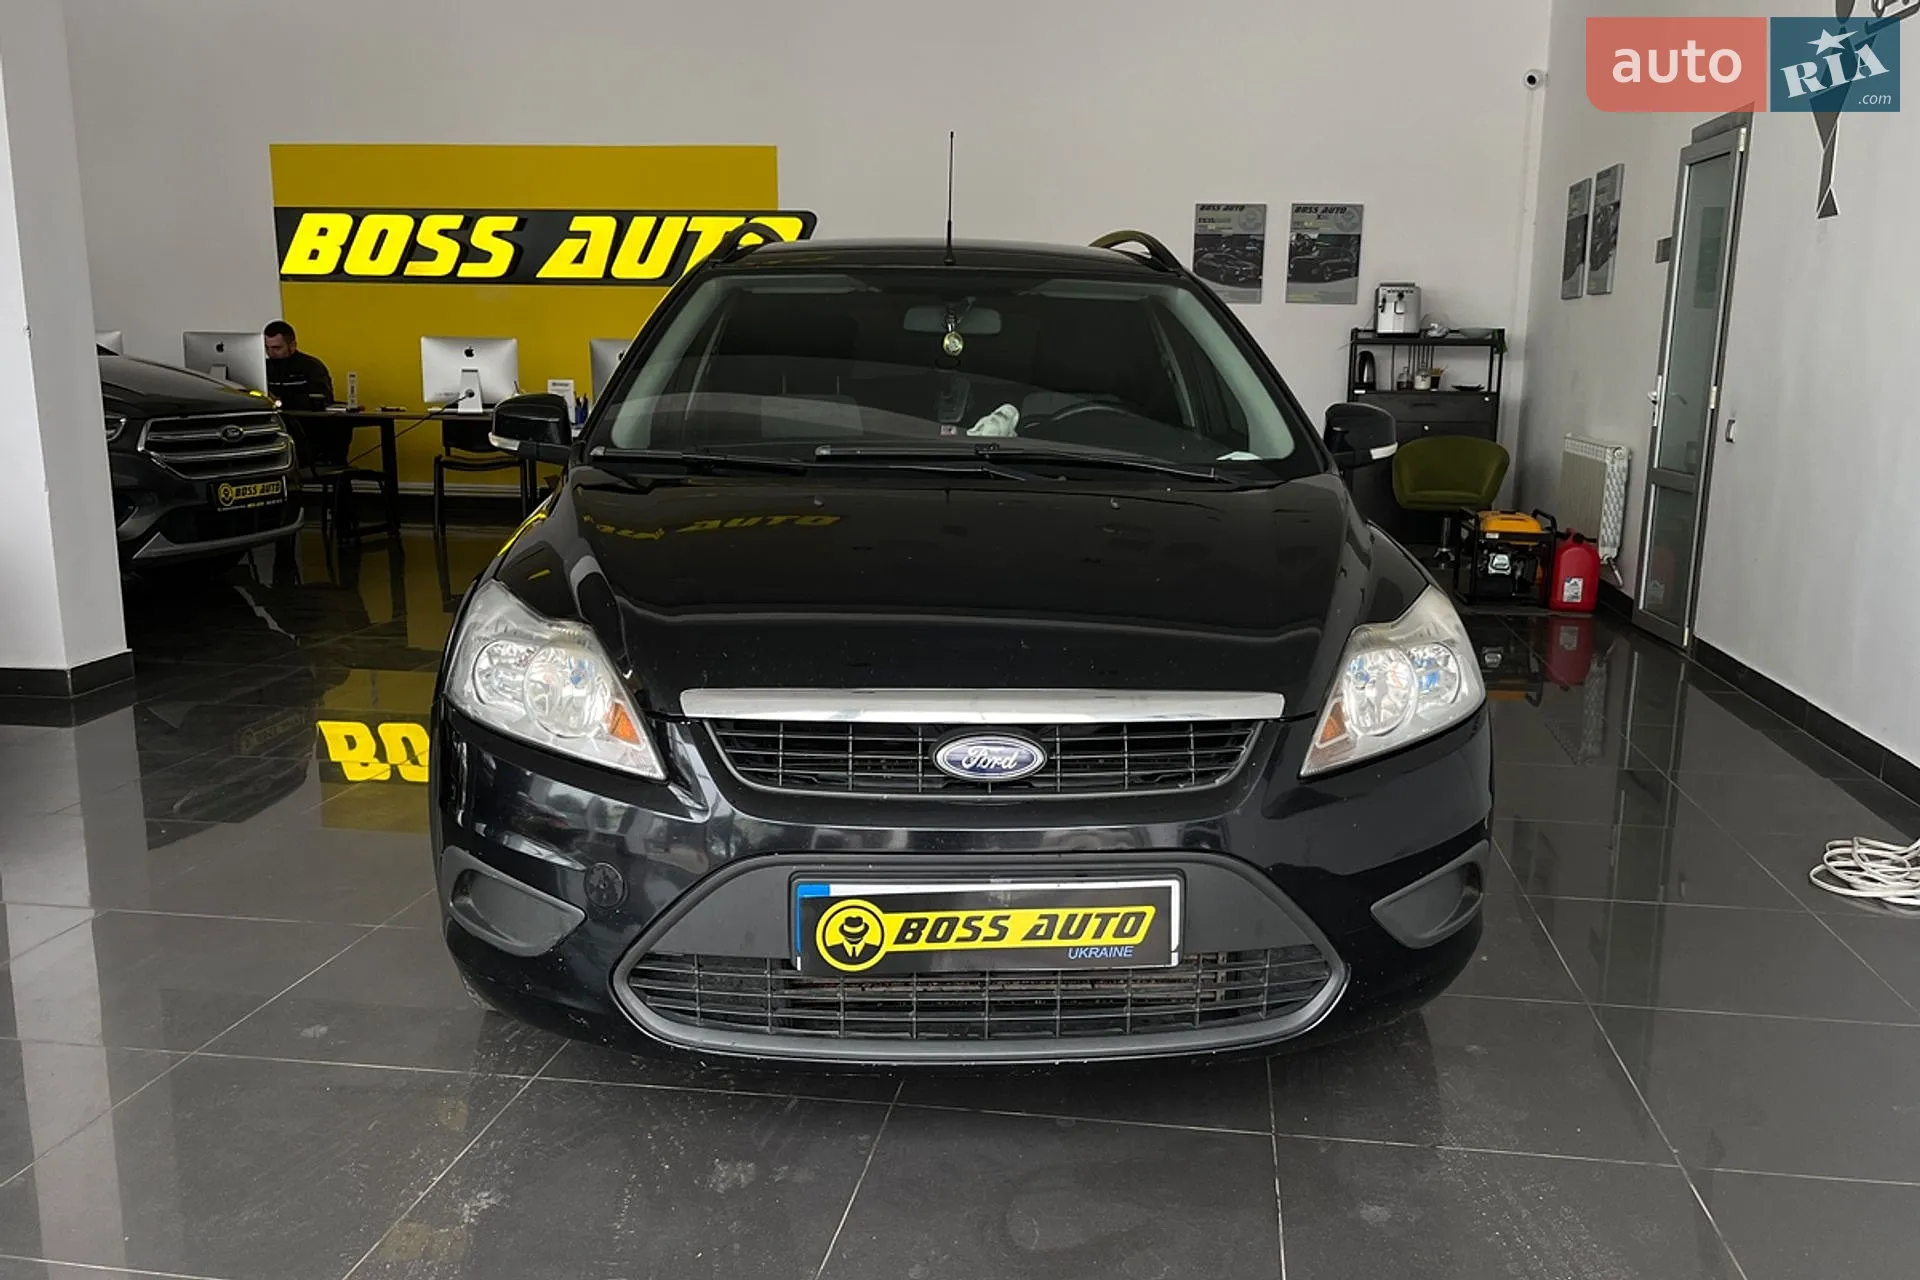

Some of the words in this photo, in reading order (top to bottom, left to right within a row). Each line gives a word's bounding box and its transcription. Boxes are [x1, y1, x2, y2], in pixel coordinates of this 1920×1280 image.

[280, 213, 519, 277] BOSS
[961, 745, 1020, 769] Ford
[892, 915, 1010, 945] BOSS
[1021, 911, 1147, 942] AUTO
[1068, 945, 1134, 959] UKRAINE
